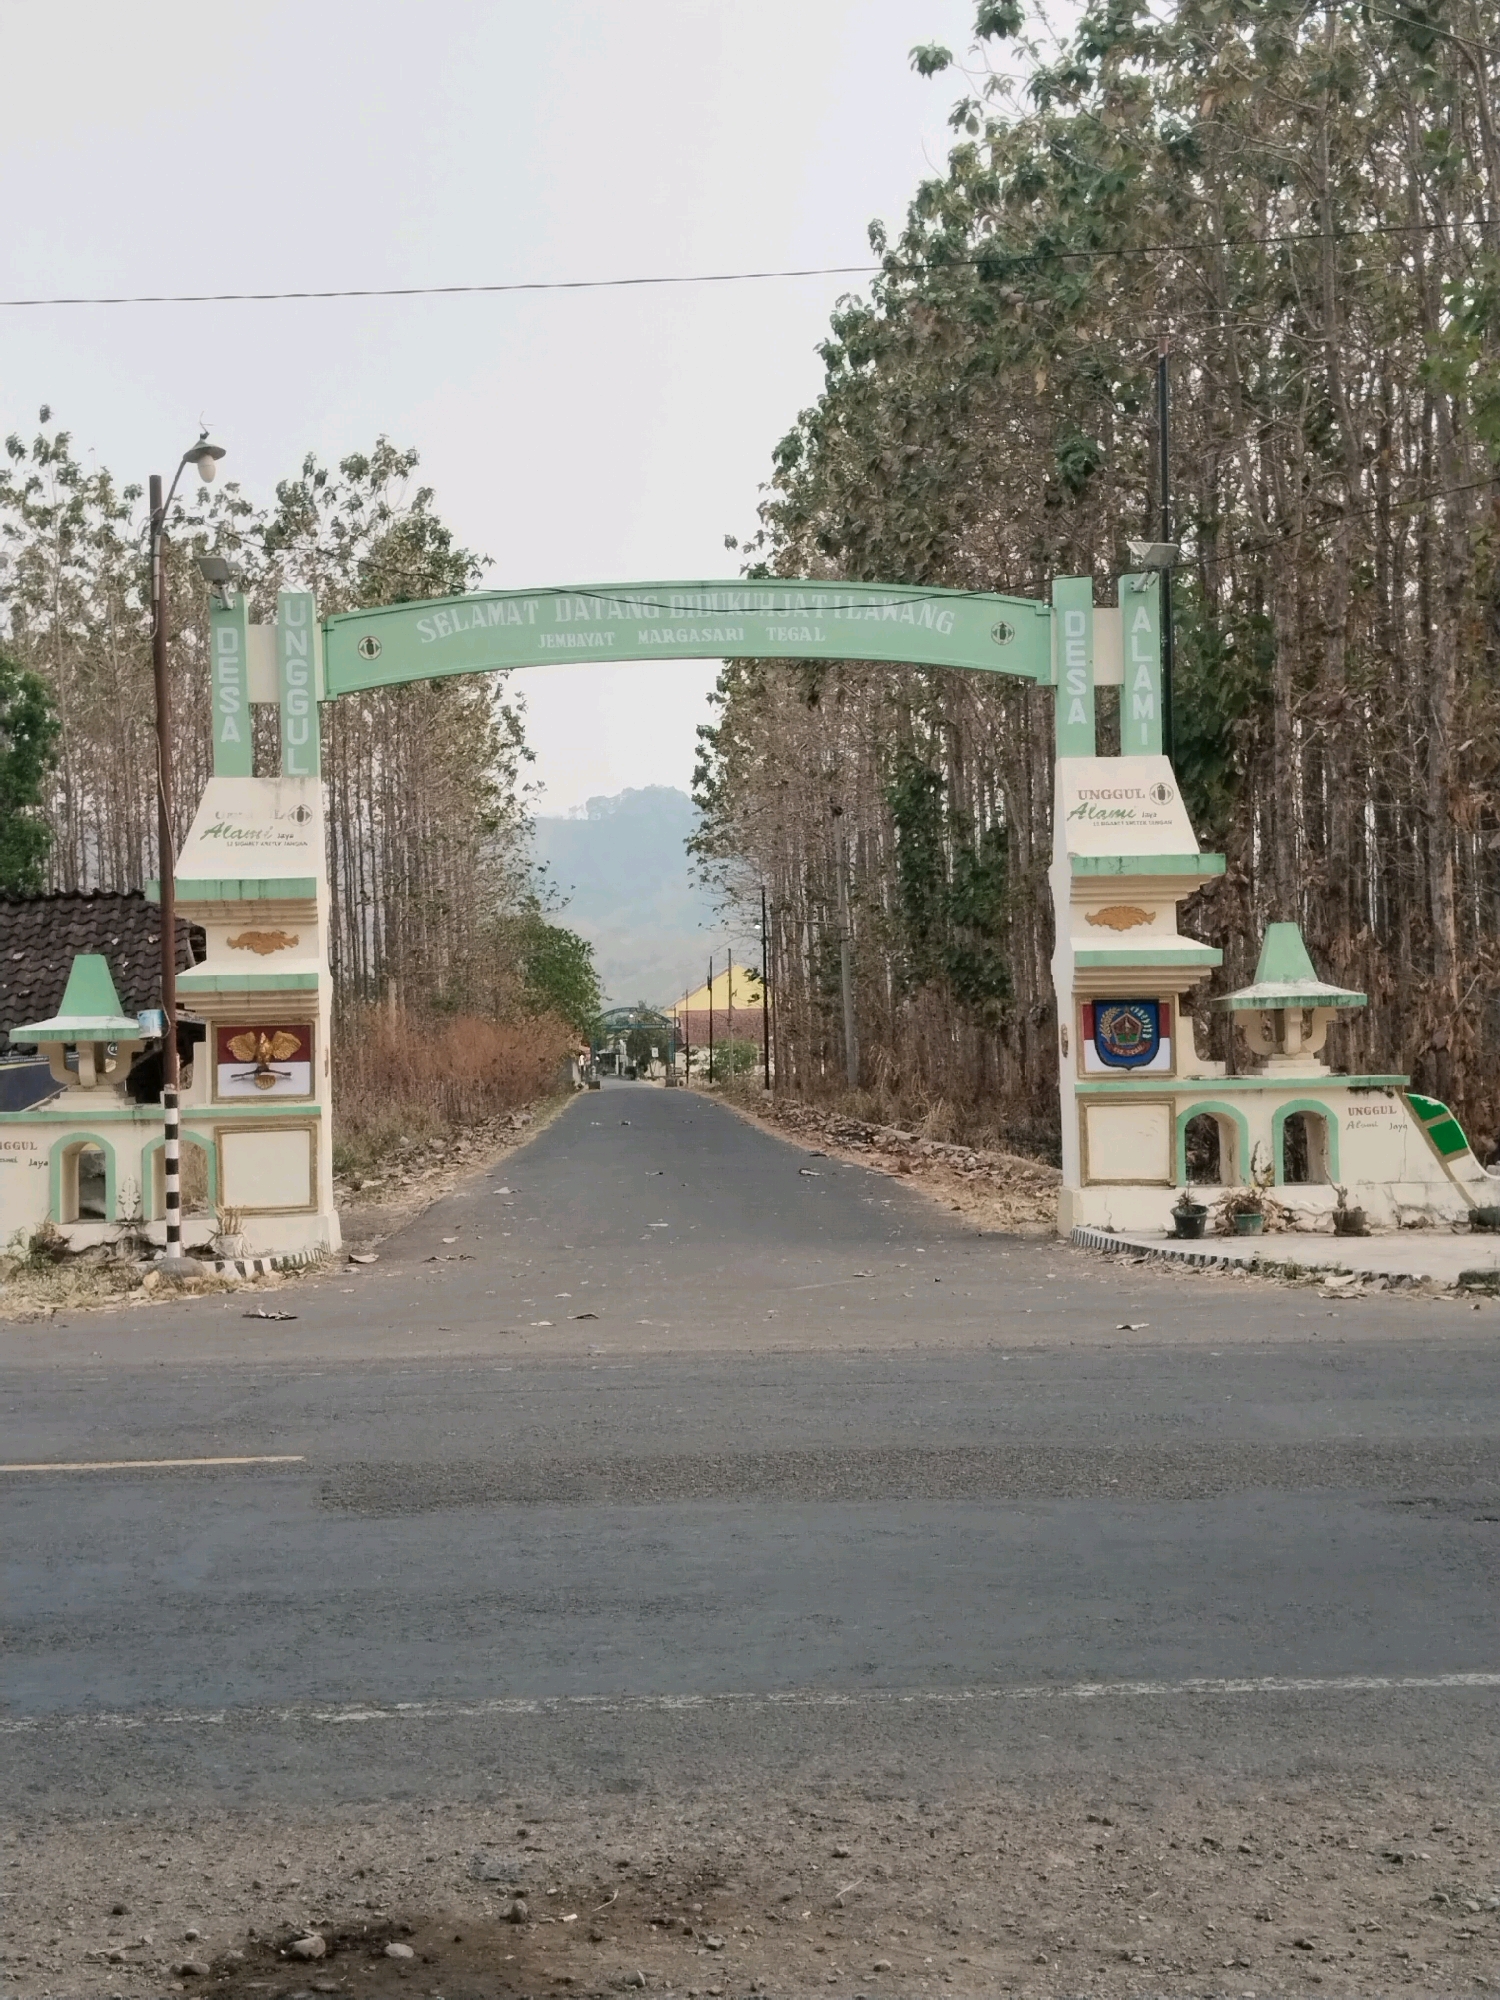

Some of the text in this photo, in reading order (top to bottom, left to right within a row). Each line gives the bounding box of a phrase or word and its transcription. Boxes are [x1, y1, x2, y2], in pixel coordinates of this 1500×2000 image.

[416, 599, 539, 644] SELAMAT
[555, 594, 660, 622] DATANG
[538, 626, 826, 648] JEMBAYAT MARGASARI TEGAL
[1064, 610, 1088, 725] DESA
[1131, 606, 1154, 745] ALAMI
[216, 627, 241, 743] DESA
[284, 600, 309, 775] UNGGUL
[1077, 788, 1146, 800] UNGGUL
[1066, 801, 1137, 822] Alami
[200, 821, 274, 841] Alami
[1347, 1105, 1397, 1116] UNGGUL
[1389, 1122, 1408, 1132] Jaya
